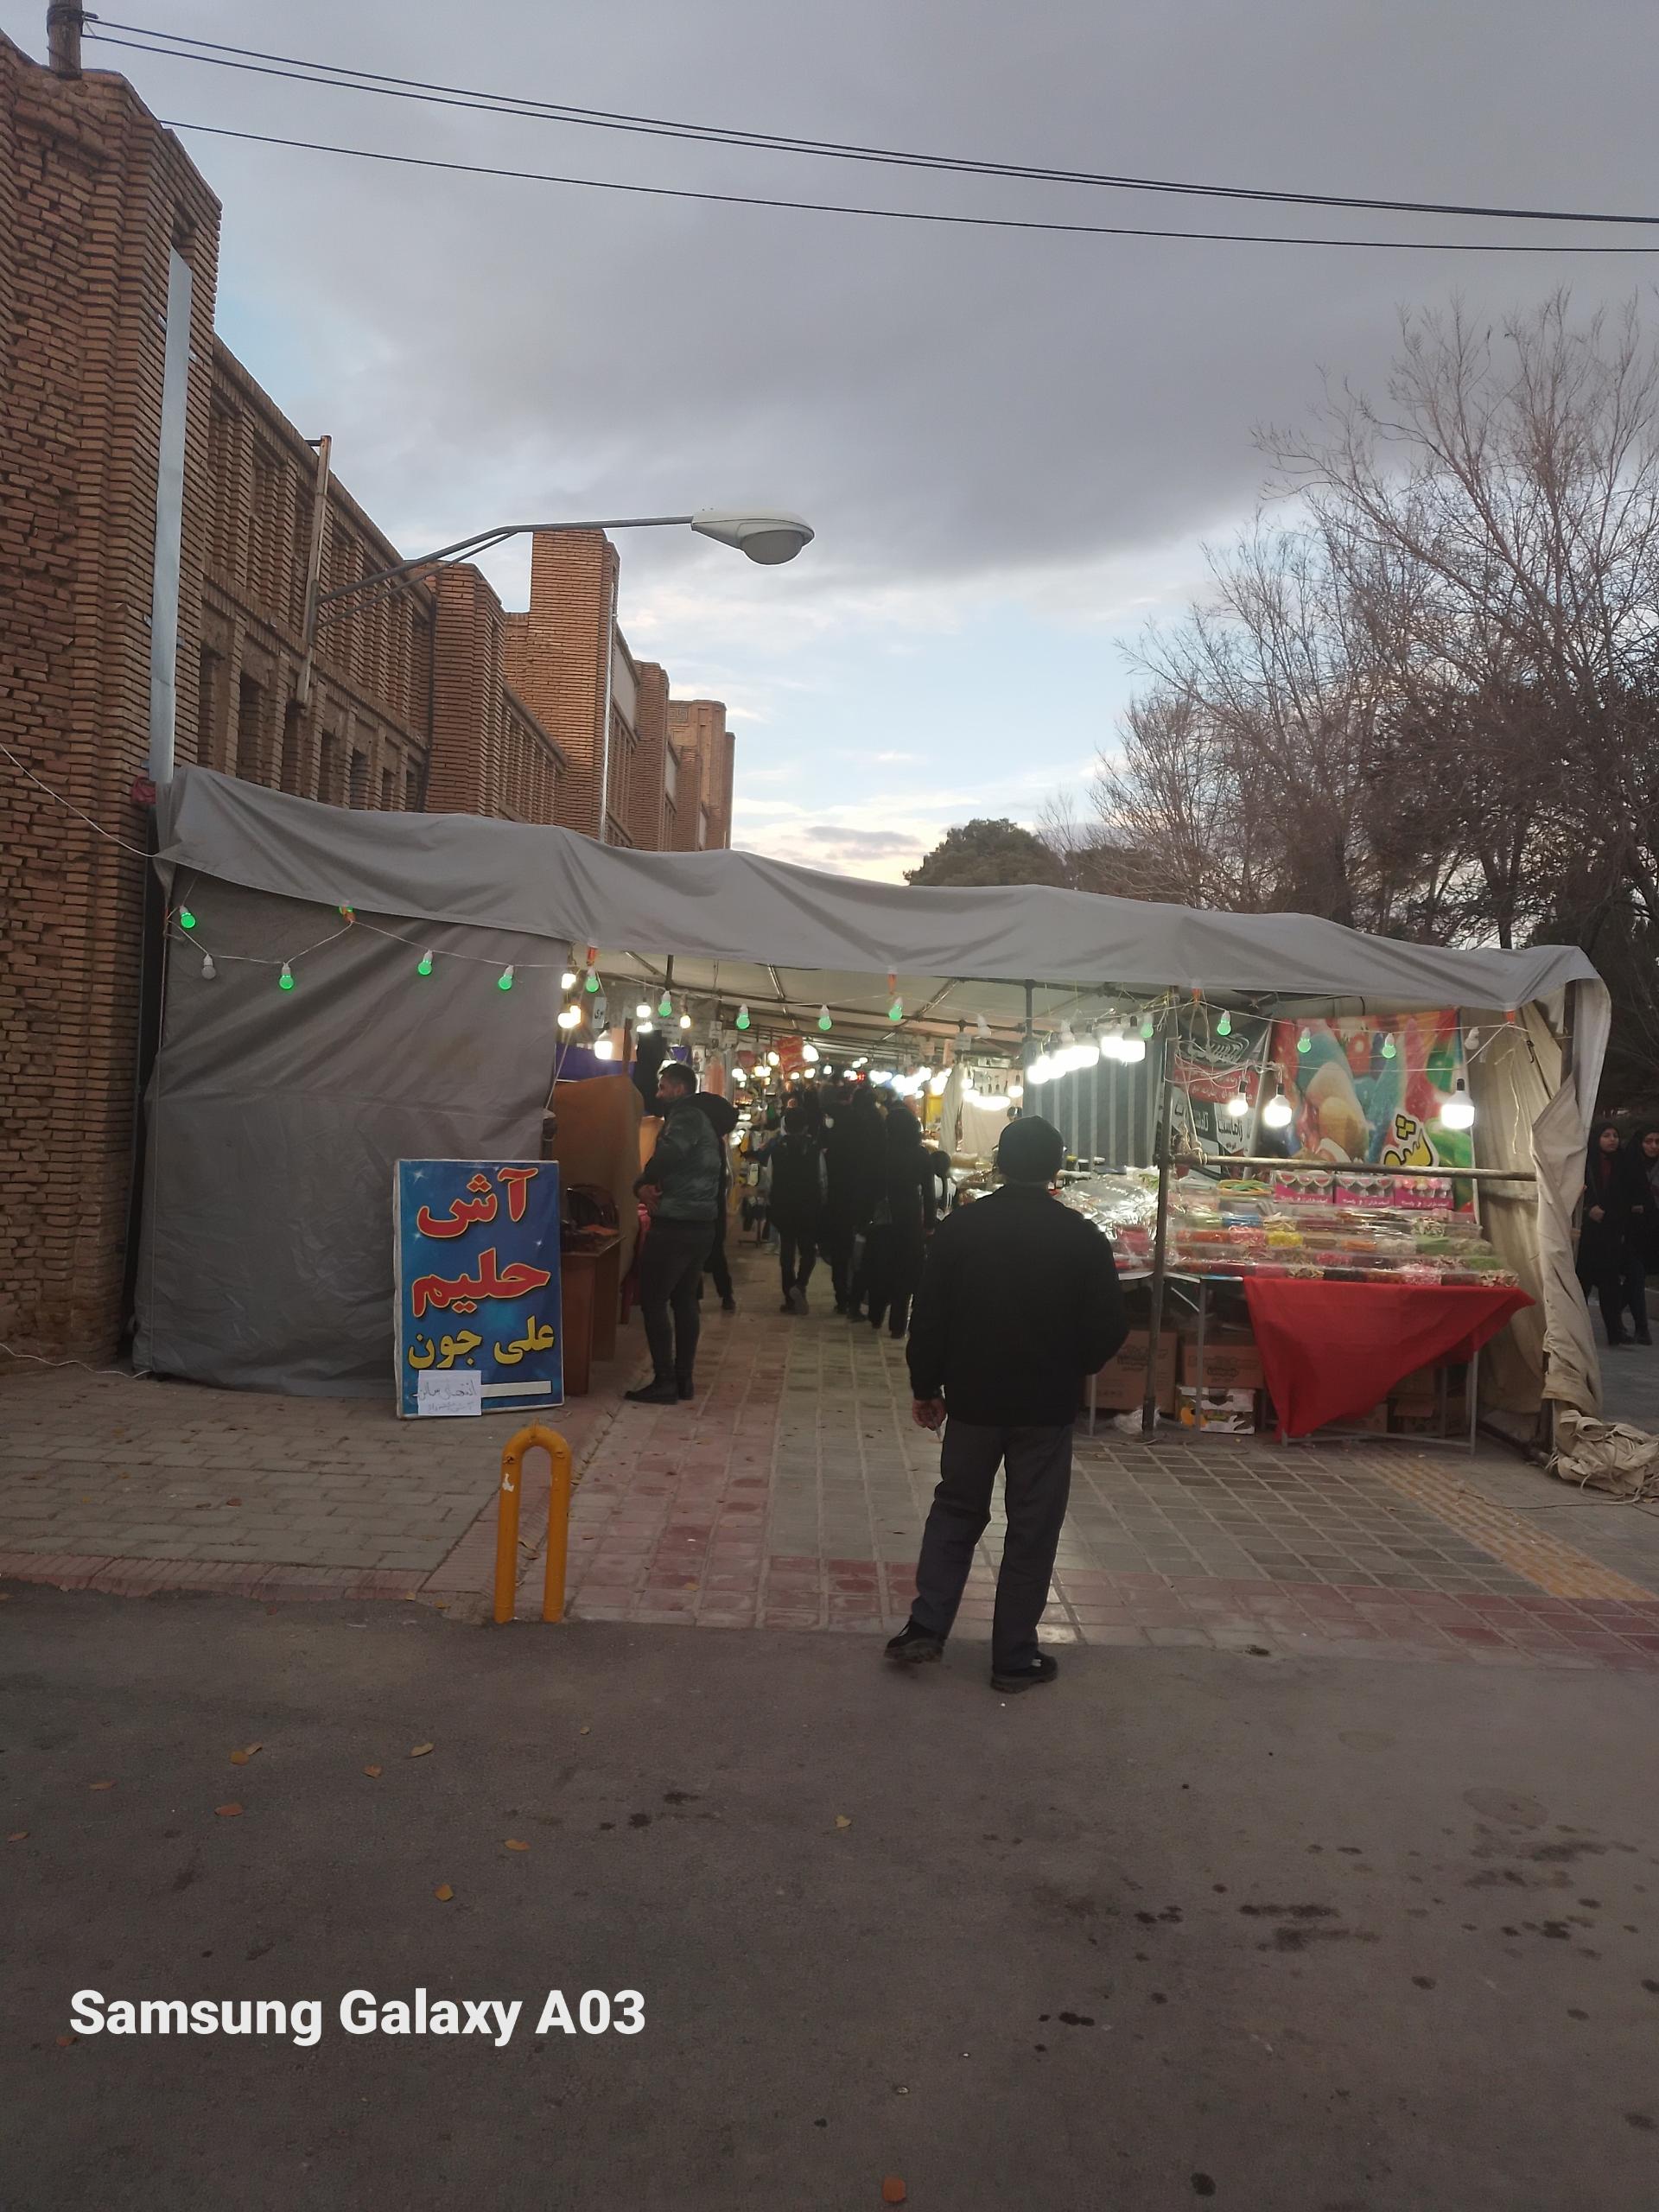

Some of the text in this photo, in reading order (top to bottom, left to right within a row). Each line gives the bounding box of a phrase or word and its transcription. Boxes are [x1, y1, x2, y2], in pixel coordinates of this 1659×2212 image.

[416, 1167, 538, 1238] آش
[411, 1247, 551, 1318] حلیم
[408, 1315, 555, 1370] علی جون
